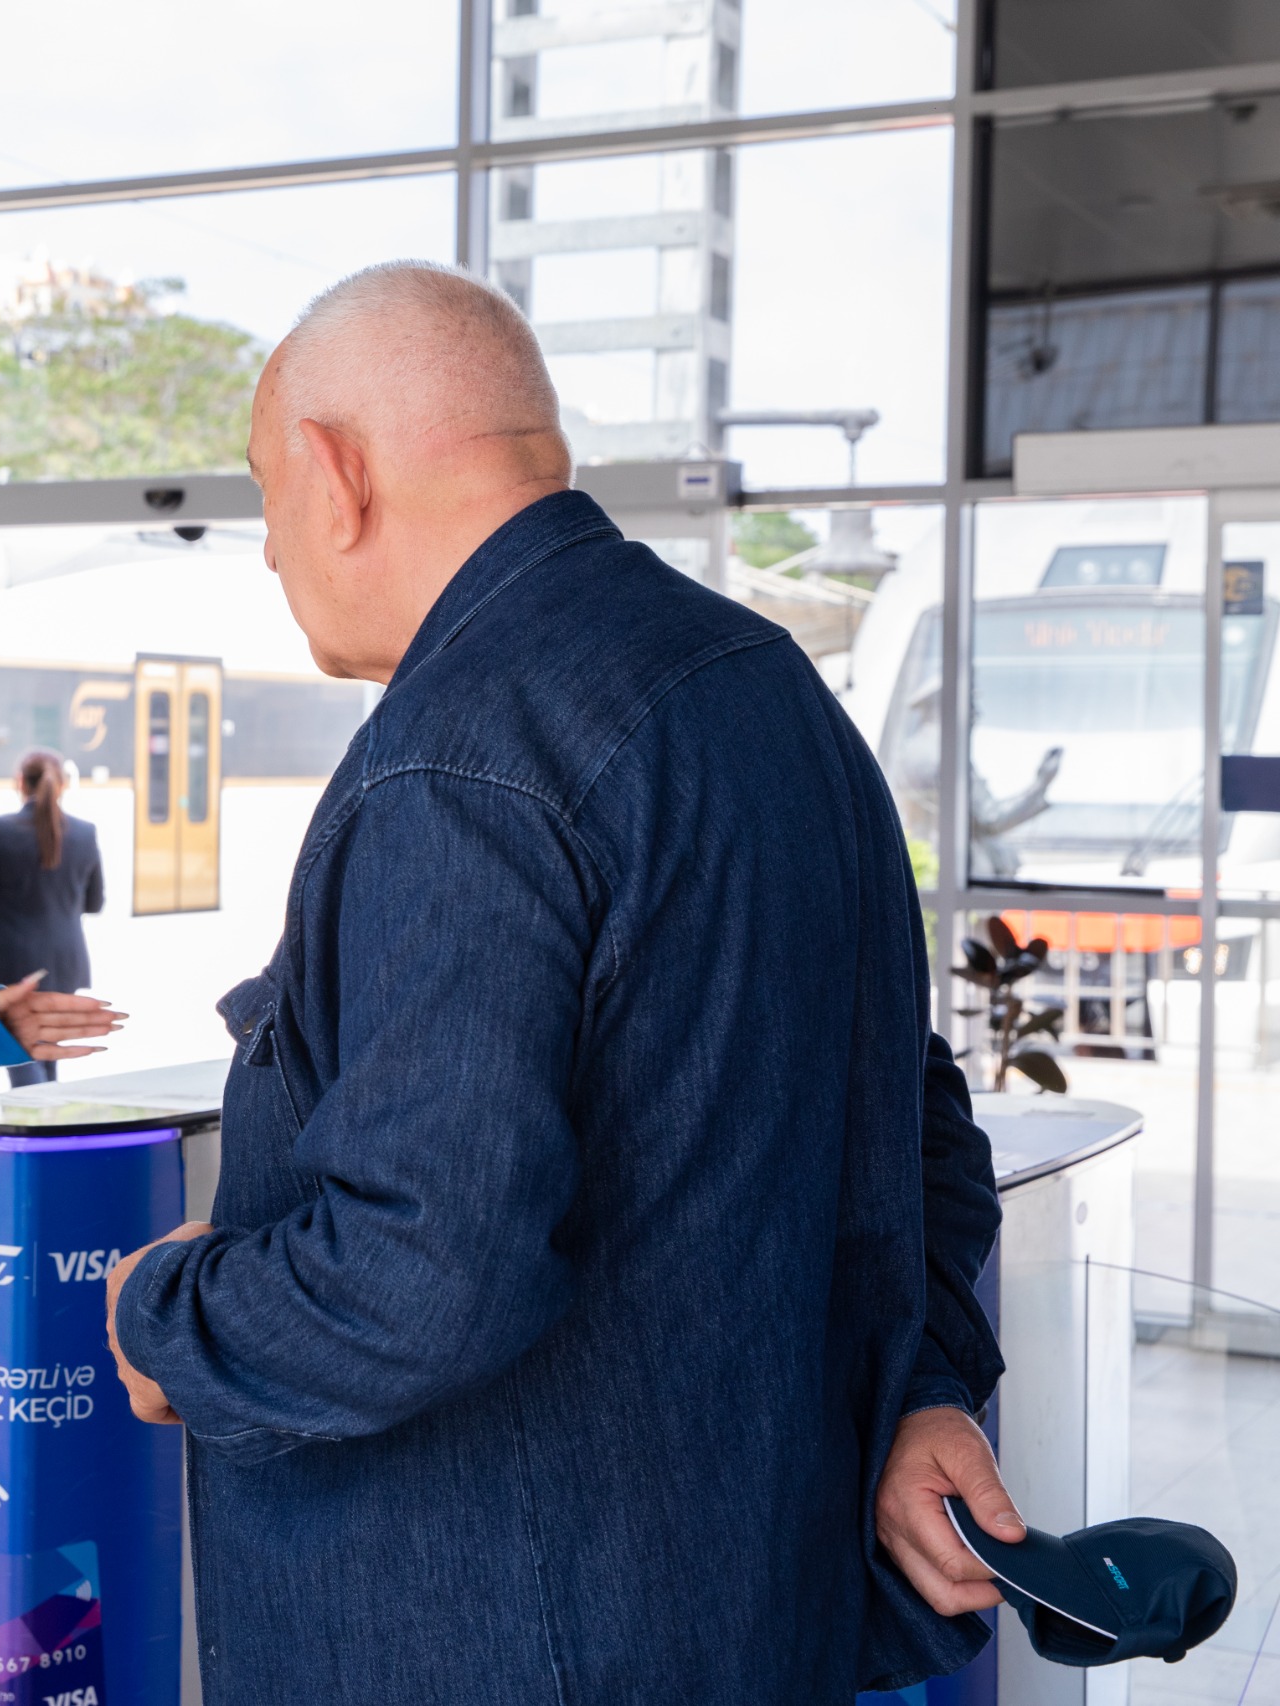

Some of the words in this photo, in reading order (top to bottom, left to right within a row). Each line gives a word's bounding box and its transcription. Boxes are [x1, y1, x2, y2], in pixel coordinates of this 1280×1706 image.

[47, 1248, 121, 1283] VISA
[63, 1365, 95, 1387] VƏ
[9, 1390, 94, 1428] KEÇİD
[39, 1644, 86, 1669] 8910
